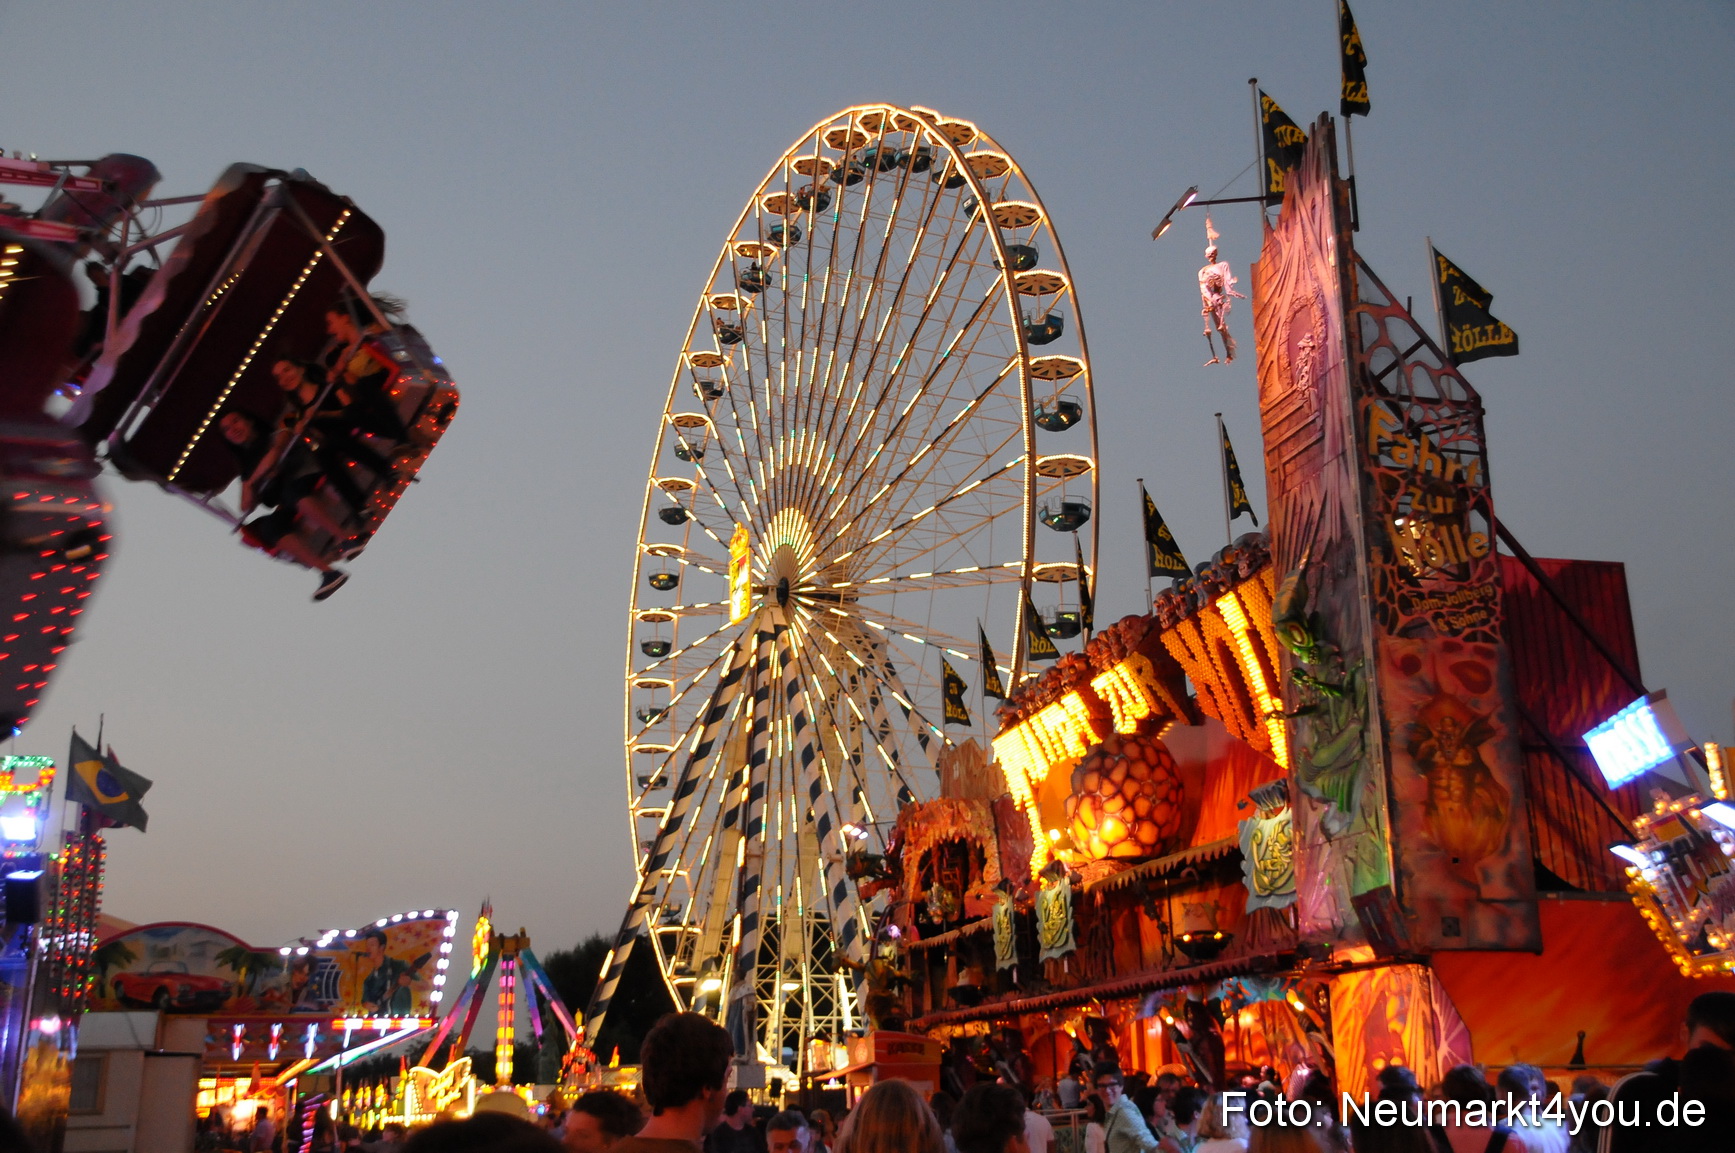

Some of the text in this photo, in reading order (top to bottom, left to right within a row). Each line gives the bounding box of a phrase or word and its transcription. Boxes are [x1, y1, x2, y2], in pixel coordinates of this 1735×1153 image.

[1368, 401, 1483, 487] Fahrt
[1408, 485, 1457, 514] zur
[1384, 513, 1489, 569] Hölle
[1090, 650, 1190, 735] ZUR
